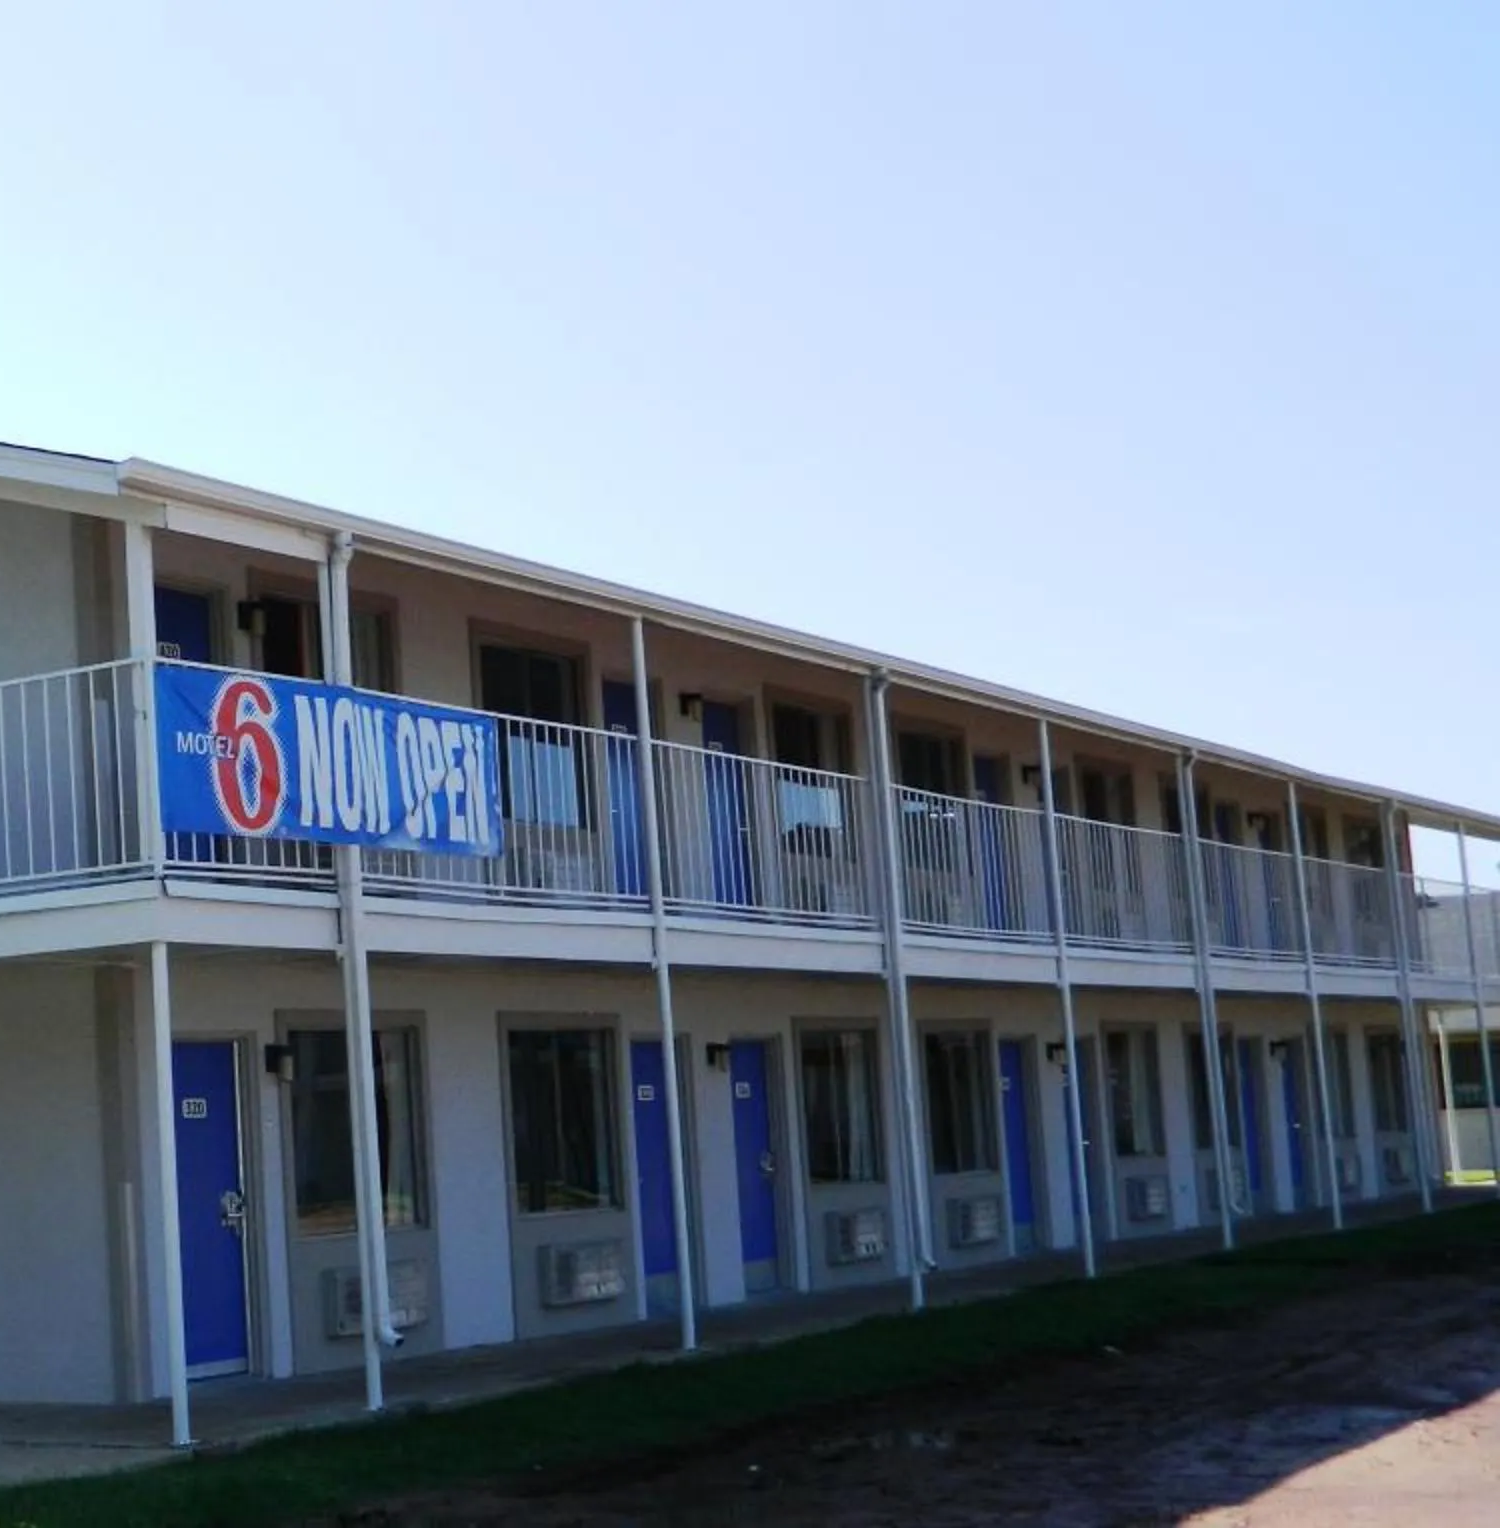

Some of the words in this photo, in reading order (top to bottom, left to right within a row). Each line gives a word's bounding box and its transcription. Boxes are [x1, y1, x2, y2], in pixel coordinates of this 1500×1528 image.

[176, 731, 236, 759] MOTEL
[213, 677, 284, 833] 6
[294, 695, 390, 835] NOW
